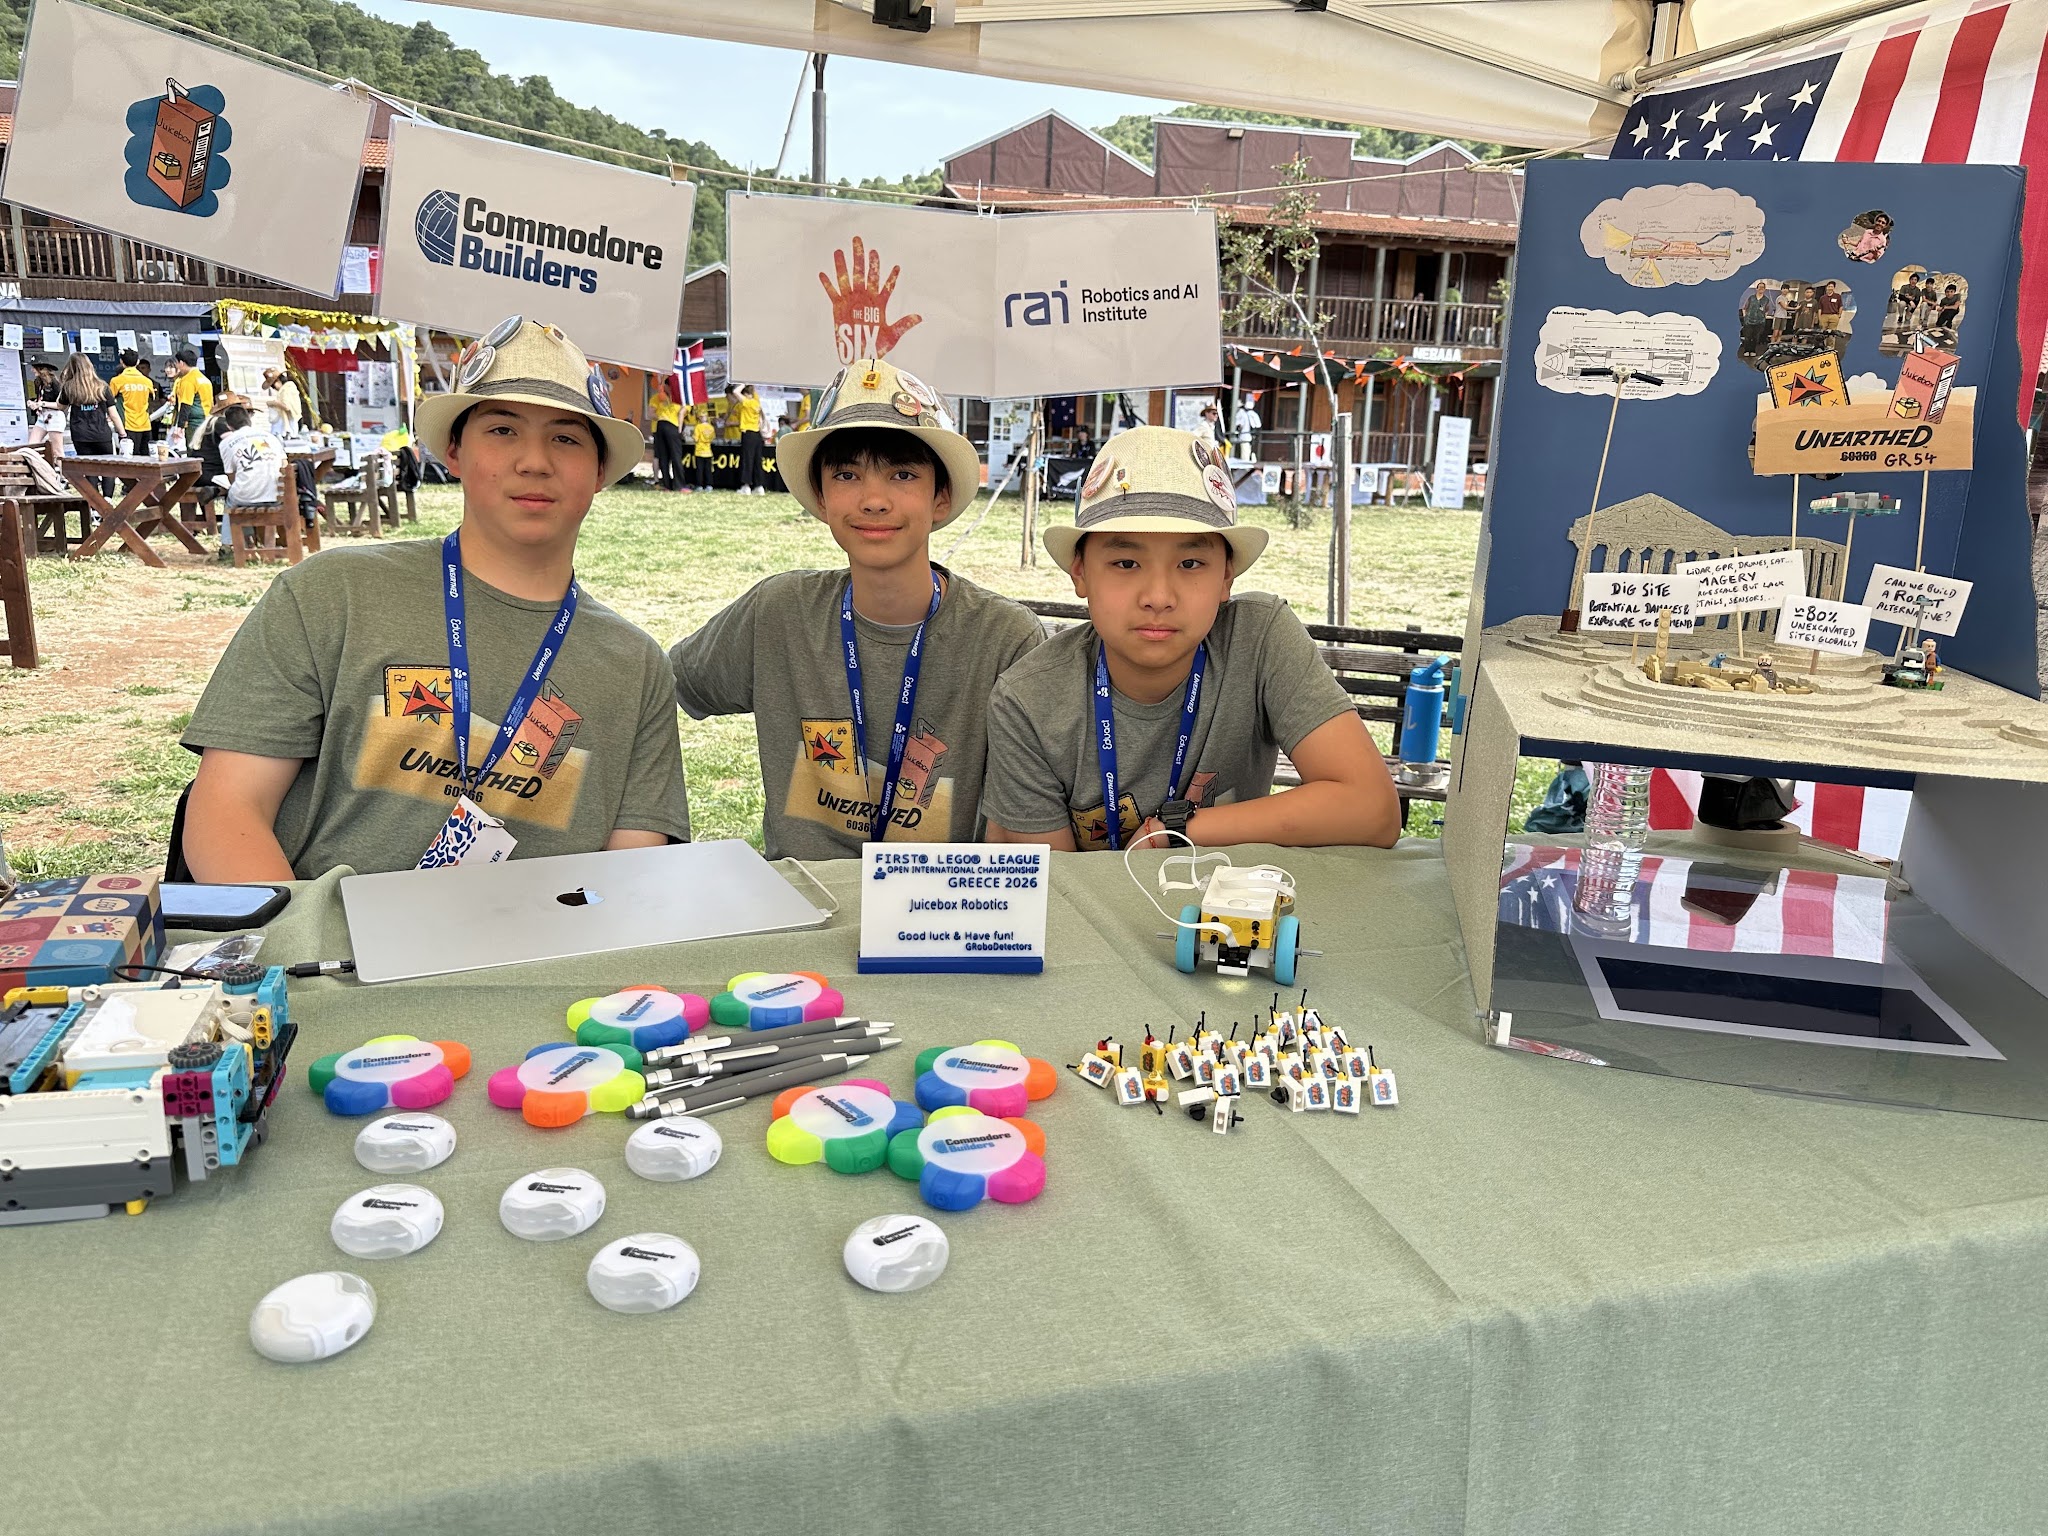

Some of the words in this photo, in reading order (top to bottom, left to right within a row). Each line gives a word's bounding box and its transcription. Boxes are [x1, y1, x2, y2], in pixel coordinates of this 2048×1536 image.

[463, 197, 663, 270] Commodore
[459, 234, 598, 294] Builders
[1082, 287, 1149, 304] Robotics
[1153, 285, 1180, 300] and
[1184, 284, 1198, 299] AI
[1004, 279, 1070, 328] rai
[853, 309, 863, 320] THE
[864, 306, 880, 323] BIG
[1083, 306, 1147, 323] Institute
[838, 323, 880, 365] SIX
[1901, 368, 1935, 388] Juicebox
[1795, 424, 1933, 451] UNEARTHED
[1699, 572, 1756, 587] MAGERY
[1742, 583, 1759, 592] BUT
[1763, 580, 1785, 589] LACK
[1885, 577, 1906, 588] CAN
[1882, 590, 1889, 599] A
[554, 609, 571, 635] Eduact
[1588, 615, 1635, 628] EXPOSURE
[1639, 619, 1651, 628] TO
[1790, 621, 1856, 638] UNEXCAVATED
[450, 618, 462, 647] Eduact
[1818, 634, 1858, 648] GLOBALLY
[847, 641, 857, 669] Eduact
[532, 647, 552, 681] UNEARTHED
[901, 676, 914, 705] Eduact
[1187, 673, 1200, 713] UNEARTHED
[1101, 719, 1112, 750] Eduact
[1176, 735, 1187, 765] Eduact
[1106, 771, 1116, 812] UNEARTHED
[846, 820, 871, 834] 6036
[990, 855, 1040, 865] LEAGUE
[887, 866, 909, 874] OPEN
[911, 866, 975, 874] INTERNATIONAL
[977, 866, 1039, 874] CHAMPIONSHIP
[948, 877, 1000, 888] GREECE
[1005, 877, 1038, 888] 2026
[909, 898, 958, 912] Juicebox
[961, 898, 1008, 911] Robotics
[898, 931, 926, 941] Good
[929, 931, 950, 941] luck
[953, 931, 961, 941] &
[965, 931, 990, 941] Have
[994, 931, 1014, 941] fun!
[965, 942, 1032, 951] GRoboDetectors
[363, 1052, 431, 1063] Commodore
[363, 1060, 410, 1068] Builders
[958, 1058, 1019, 1072] Commodore
[957, 1063, 998, 1074] Builders
[945, 1131, 1011, 1146] Commodore
[949, 1140, 995, 1154] Builders
